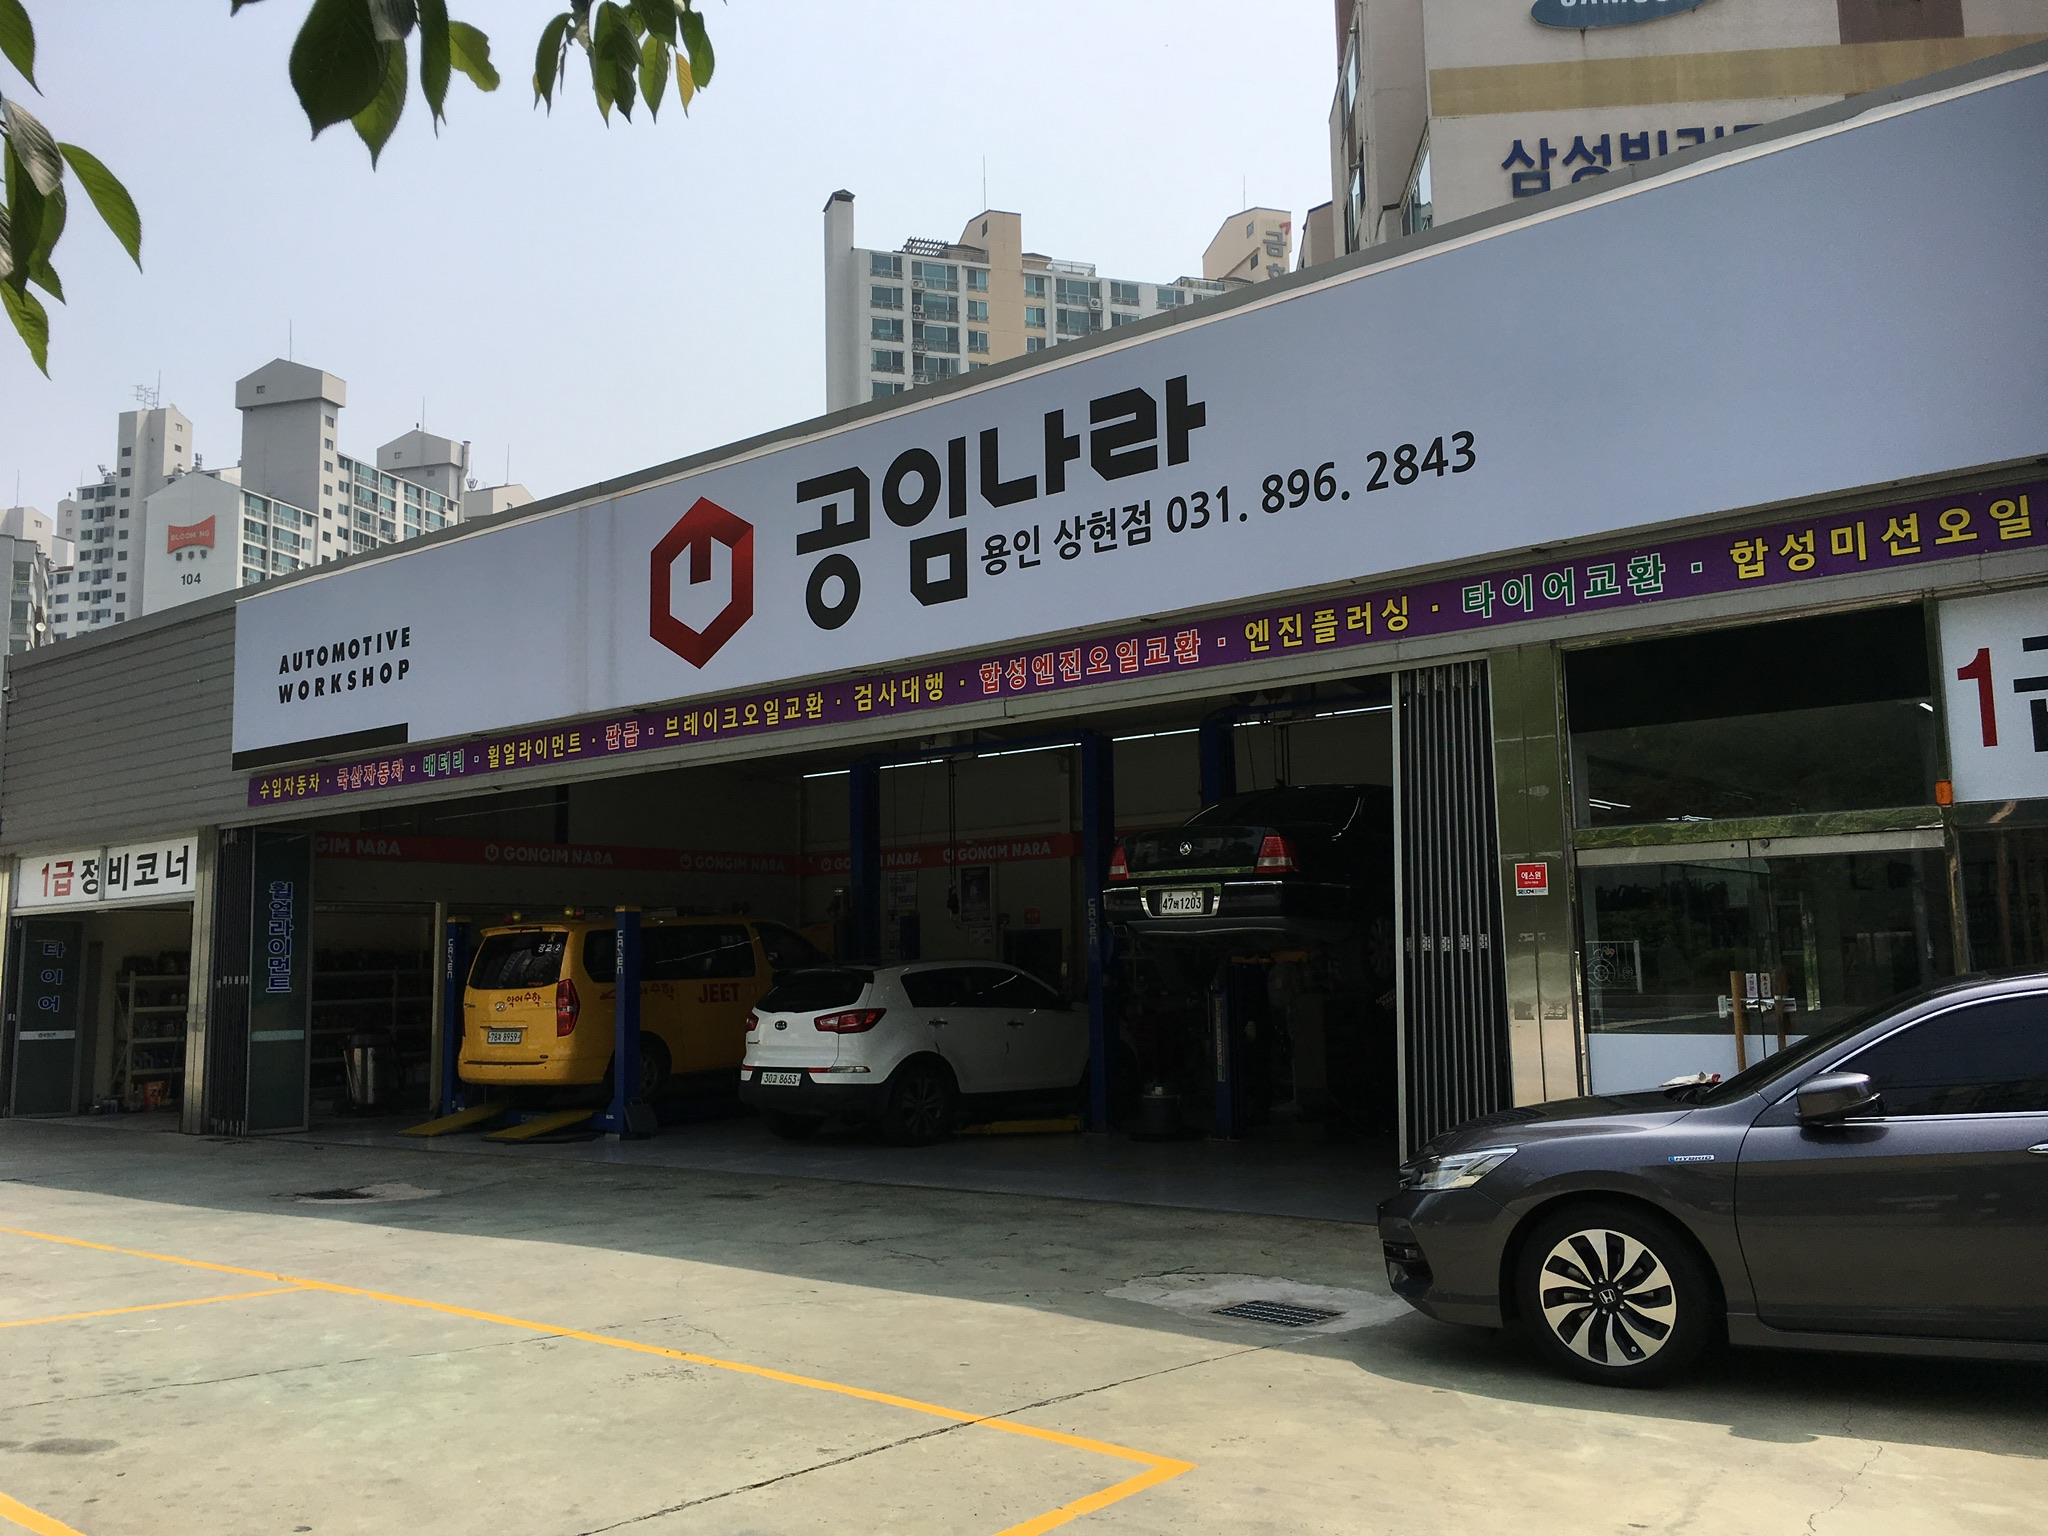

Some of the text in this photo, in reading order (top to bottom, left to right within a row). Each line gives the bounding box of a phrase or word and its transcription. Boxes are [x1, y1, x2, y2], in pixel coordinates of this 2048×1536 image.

[796, 375, 1206, 631] 공임나라
[980, 430, 1477, 576] 용인 상현점 031. 896. 2843
[181, 573, 201, 586] 104
[279, 626, 410, 675] AUTOMOTIVE
[259, 772, 320, 799] 수입자동차
[336, 759, 404, 790] 국산자동차
[422, 749, 465, 777] 배터리
[488, 732, 582, 769] 휠얼라이먼트
[605, 721, 640, 750] 판금
[664, 691, 824, 739] 브레이크오일교환
[853, 671, 944, 712] 검사대행
[979, 629, 1201, 695] 합성엔진오일교환
[1244, 594, 1410, 653] 엔진플러싱
[1462, 552, 1665, 619] 타이어교환
[279, 659, 410, 704] WORKSHOP
[503, 845, 614, 866] GONGIM NARA
[695, 856, 785, 872] GONGIM NARA
[1012, 841, 1051, 857] NARA
[38, 941, 66, 1013] 타이어
[698, 982, 740, 1003] JEET
